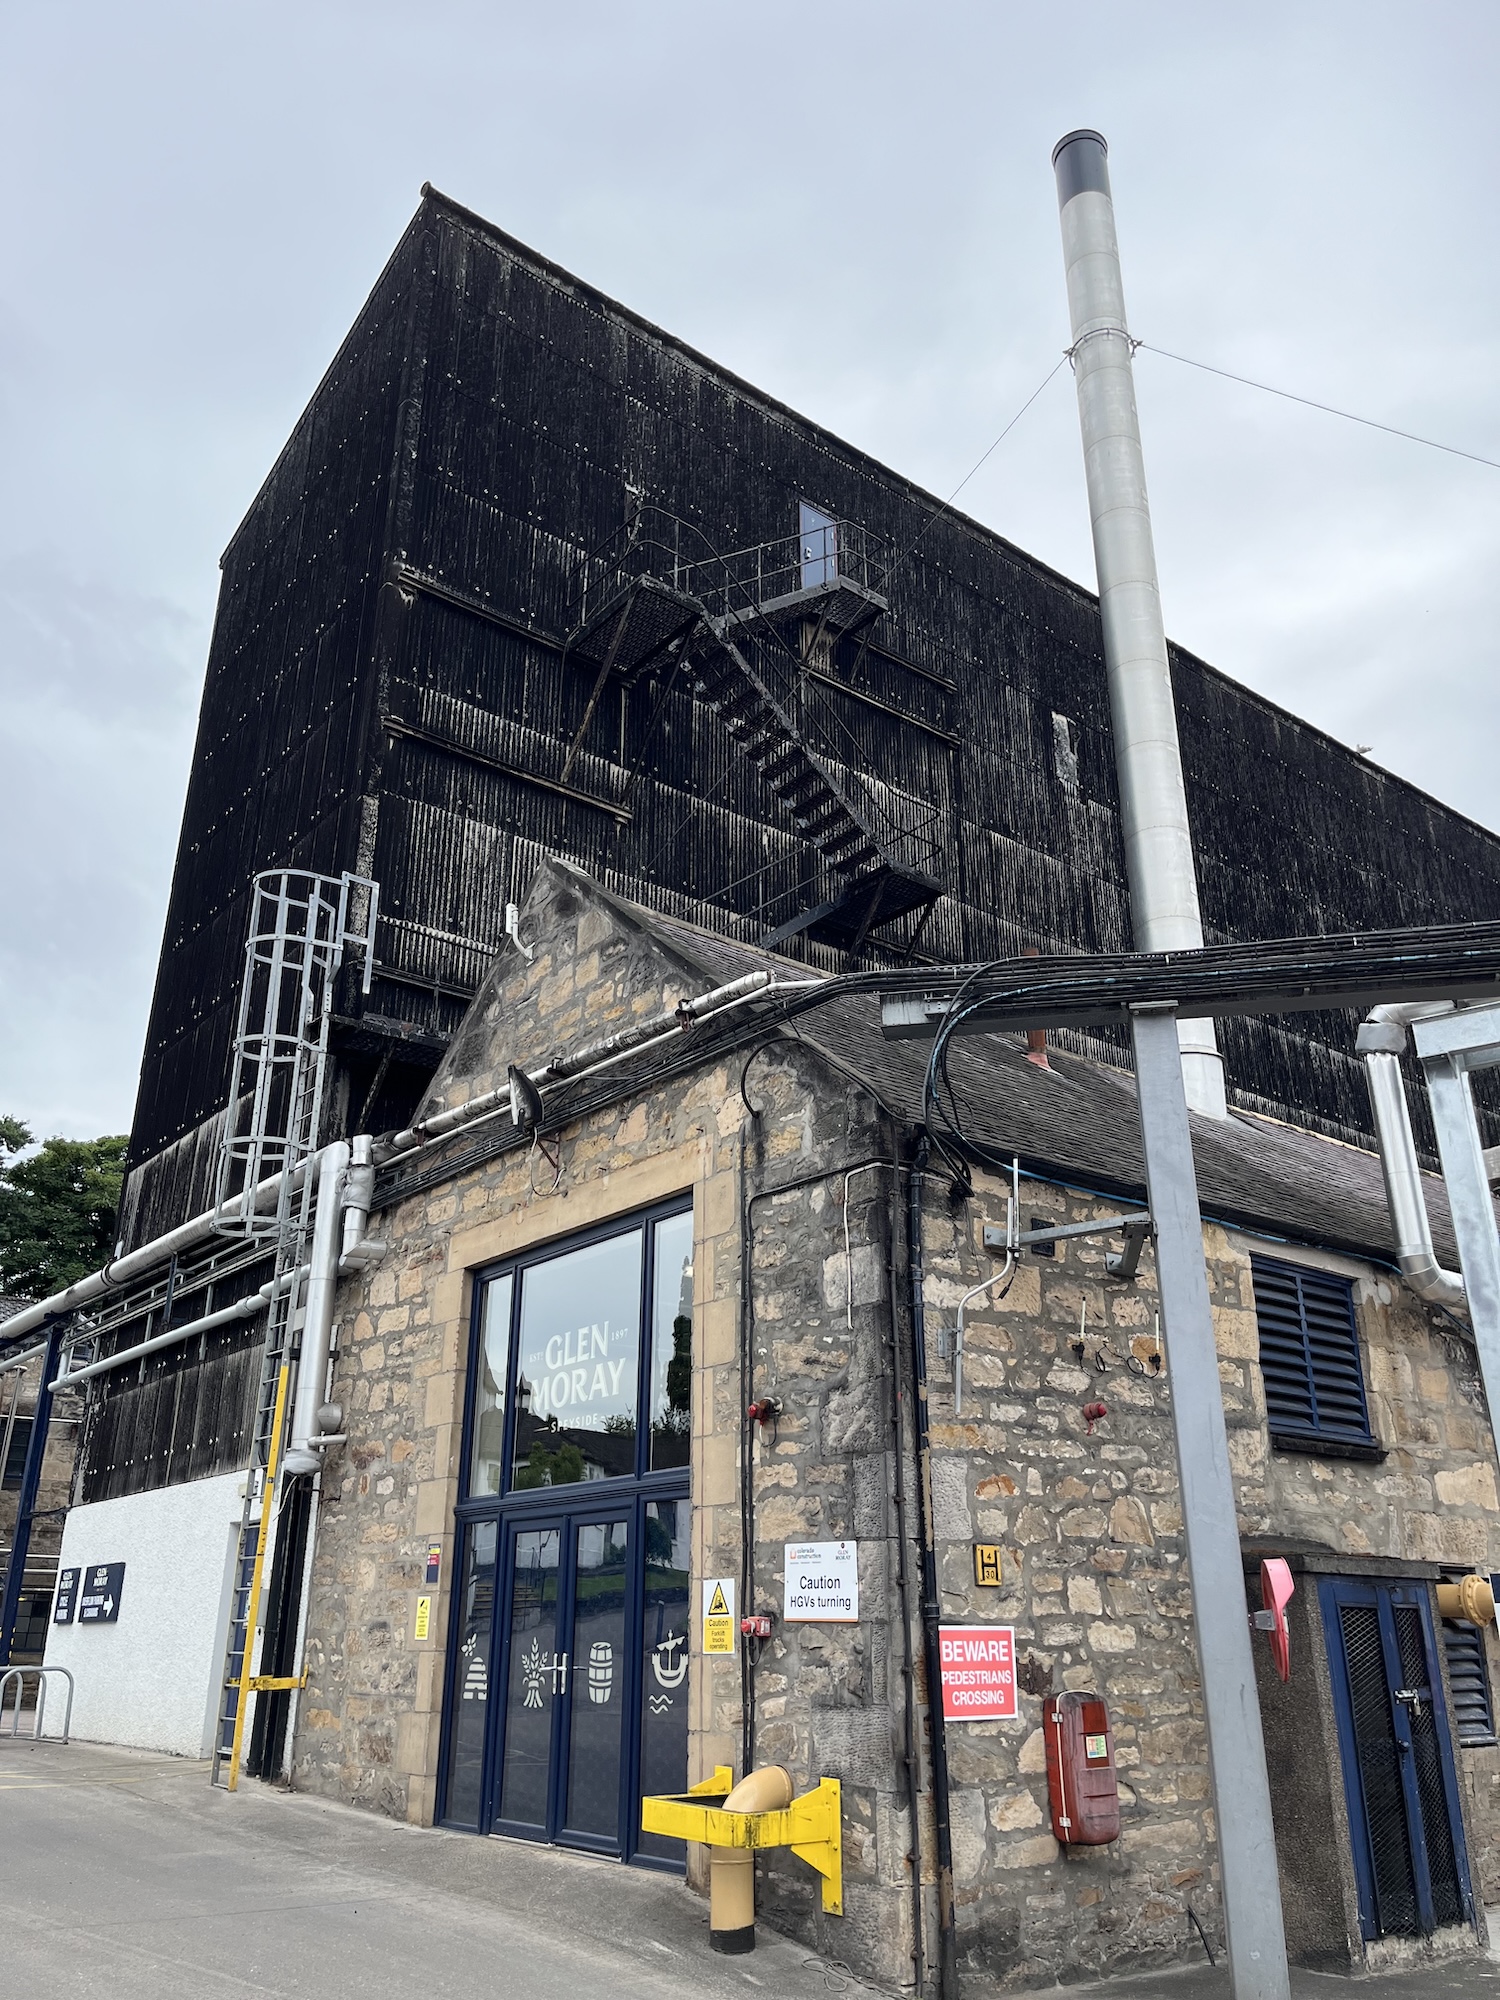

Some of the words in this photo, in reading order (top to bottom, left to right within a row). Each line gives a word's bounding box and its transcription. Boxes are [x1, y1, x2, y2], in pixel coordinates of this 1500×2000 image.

[545, 1320, 610, 1370] GLEN
[611, 1328, 629, 1341] 1897
[528, 1357, 627, 1414] MORAY
[550, 1413, 598, 1433] SPEYSIDE
[986, 1552, 992, 1561] 4
[799, 1575, 841, 1590] Caution
[985, 1570, 995, 1579] 30
[790, 1595, 815, 1608] HGVs
[817, 1595, 851, 1611] turning
[709, 1619, 729, 1627] Caution
[709, 1643, 728, 1651] operating
[942, 1640, 1010, 1662] BEWARE
[941, 1670, 1012, 1686] PEDESTRIANS
[952, 1690, 1005, 1706] CROSSING
